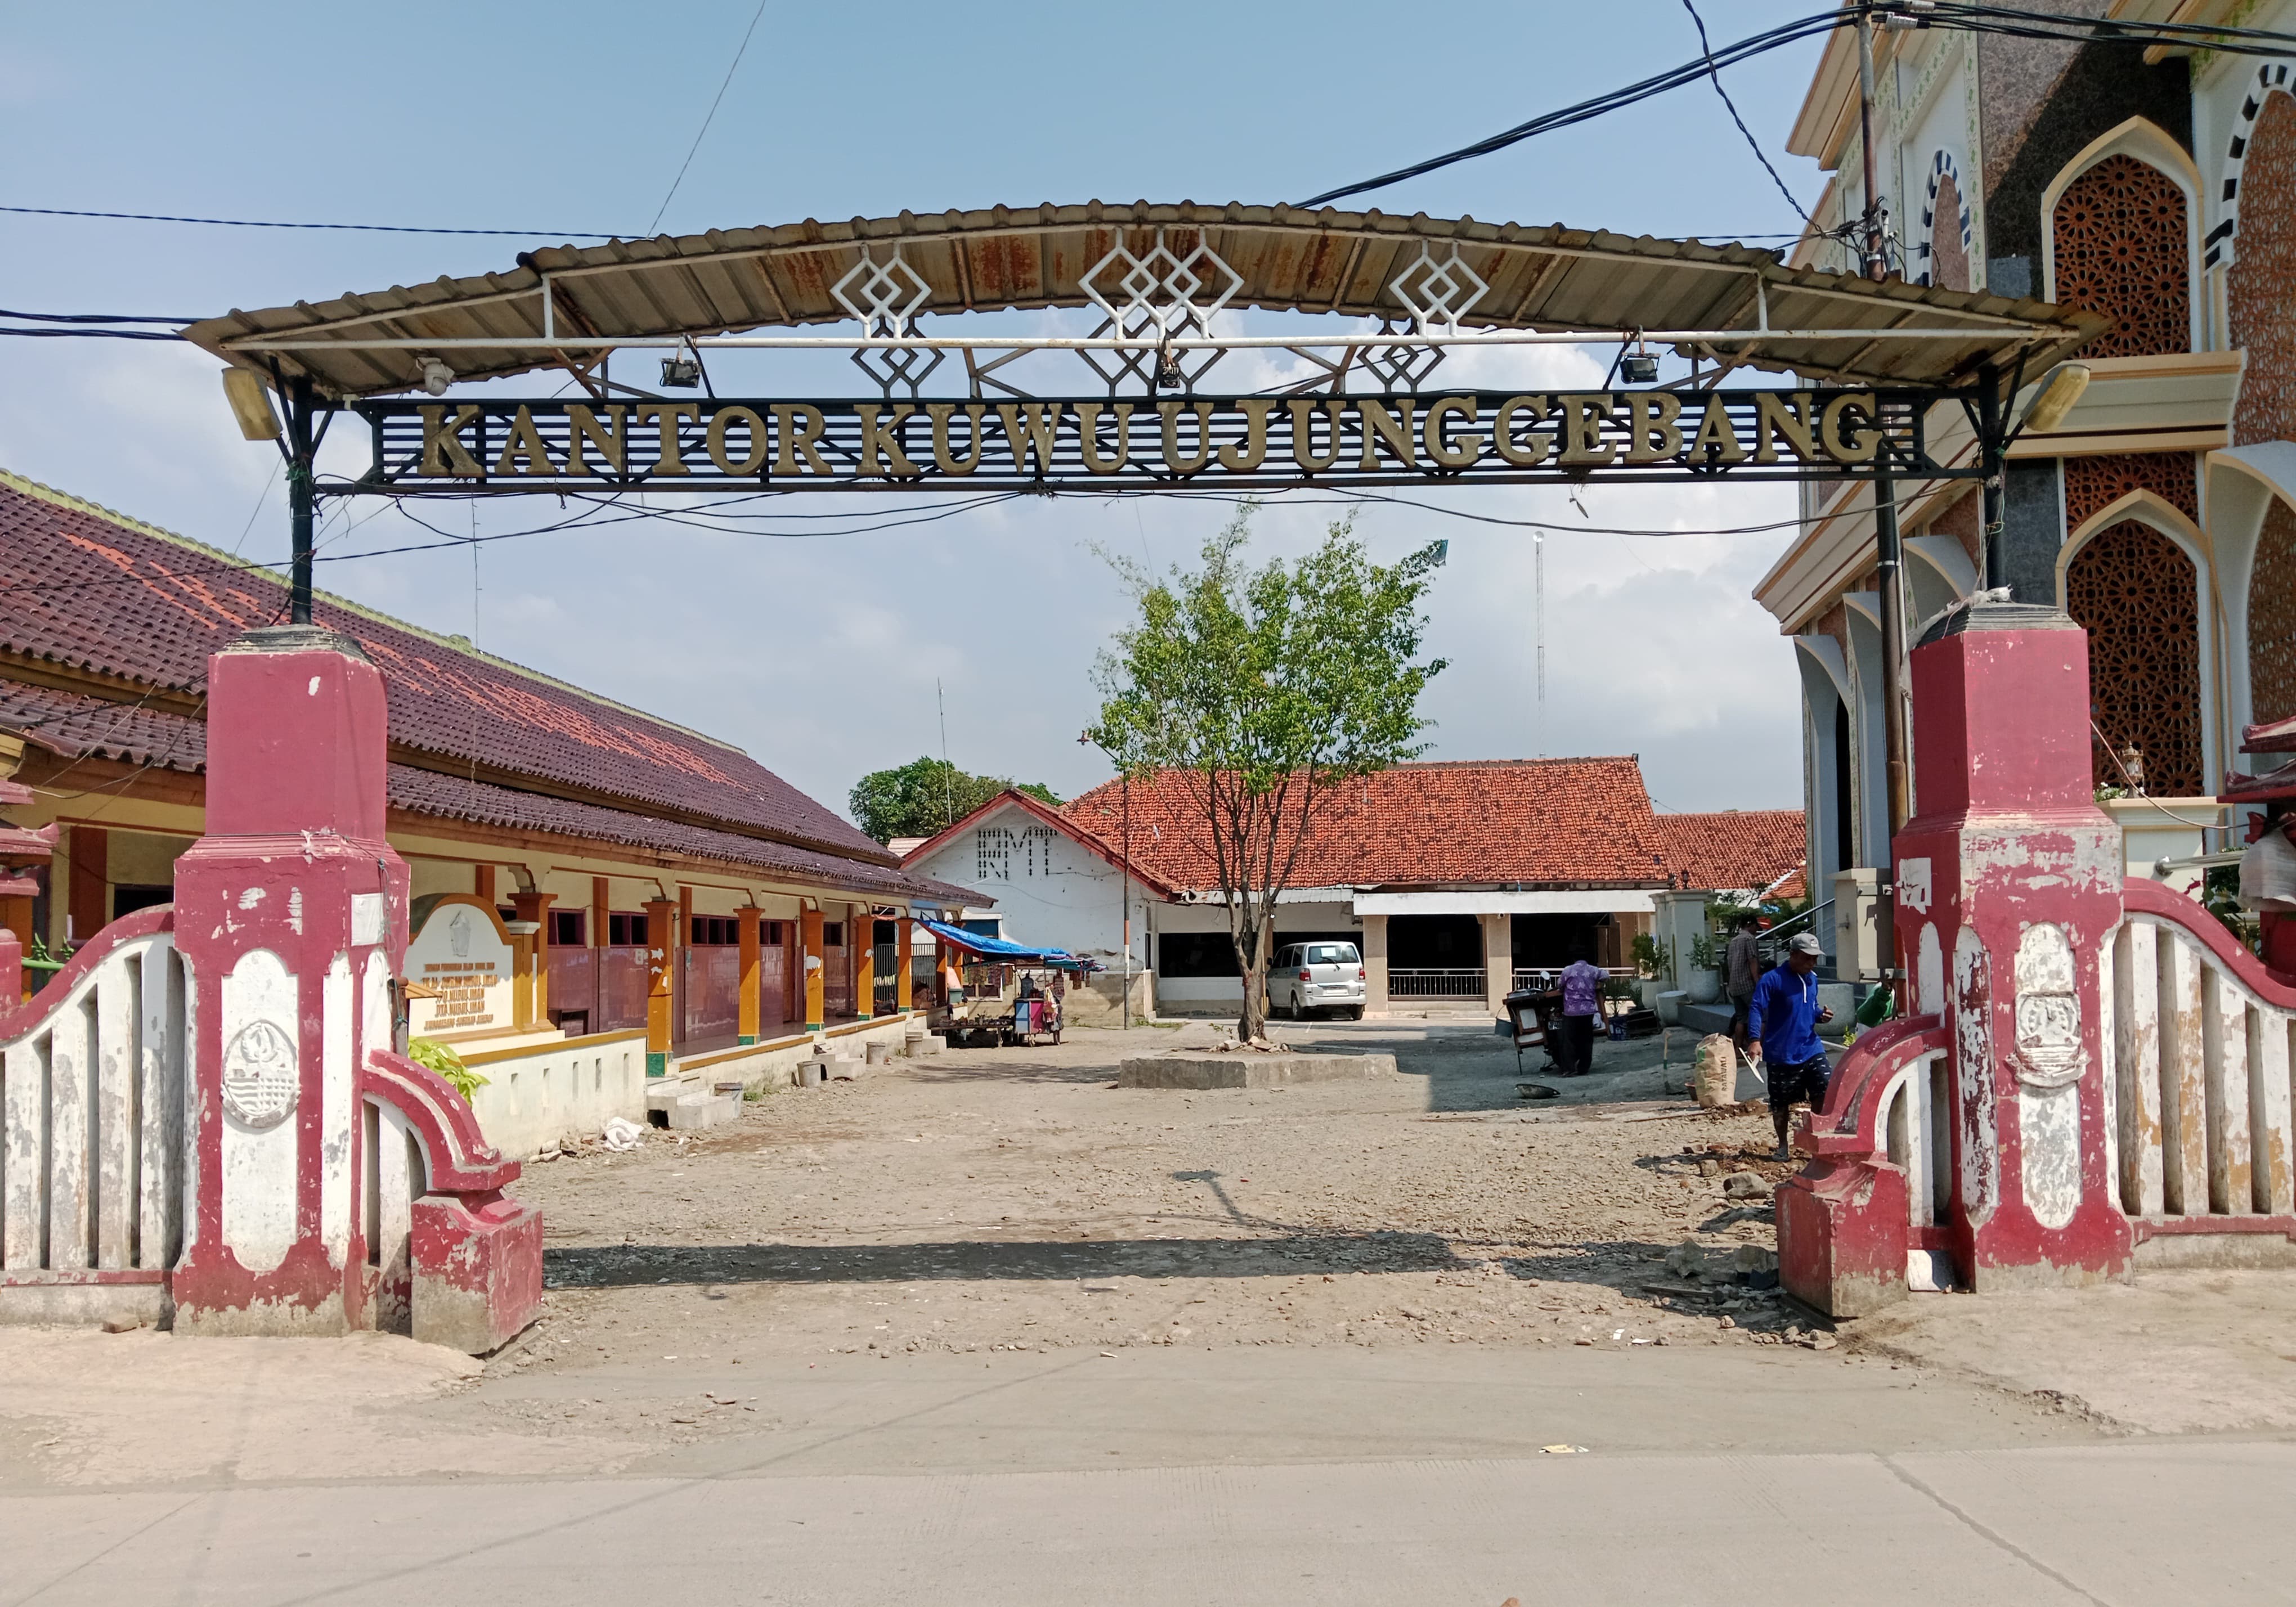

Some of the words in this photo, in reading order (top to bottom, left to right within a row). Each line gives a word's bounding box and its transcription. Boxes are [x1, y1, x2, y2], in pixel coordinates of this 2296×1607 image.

[415, 403, 834, 477] KANTOR
[853, 402, 1134, 476] KUWU
[1156, 390, 1884, 474] UJUNGGEBANG
